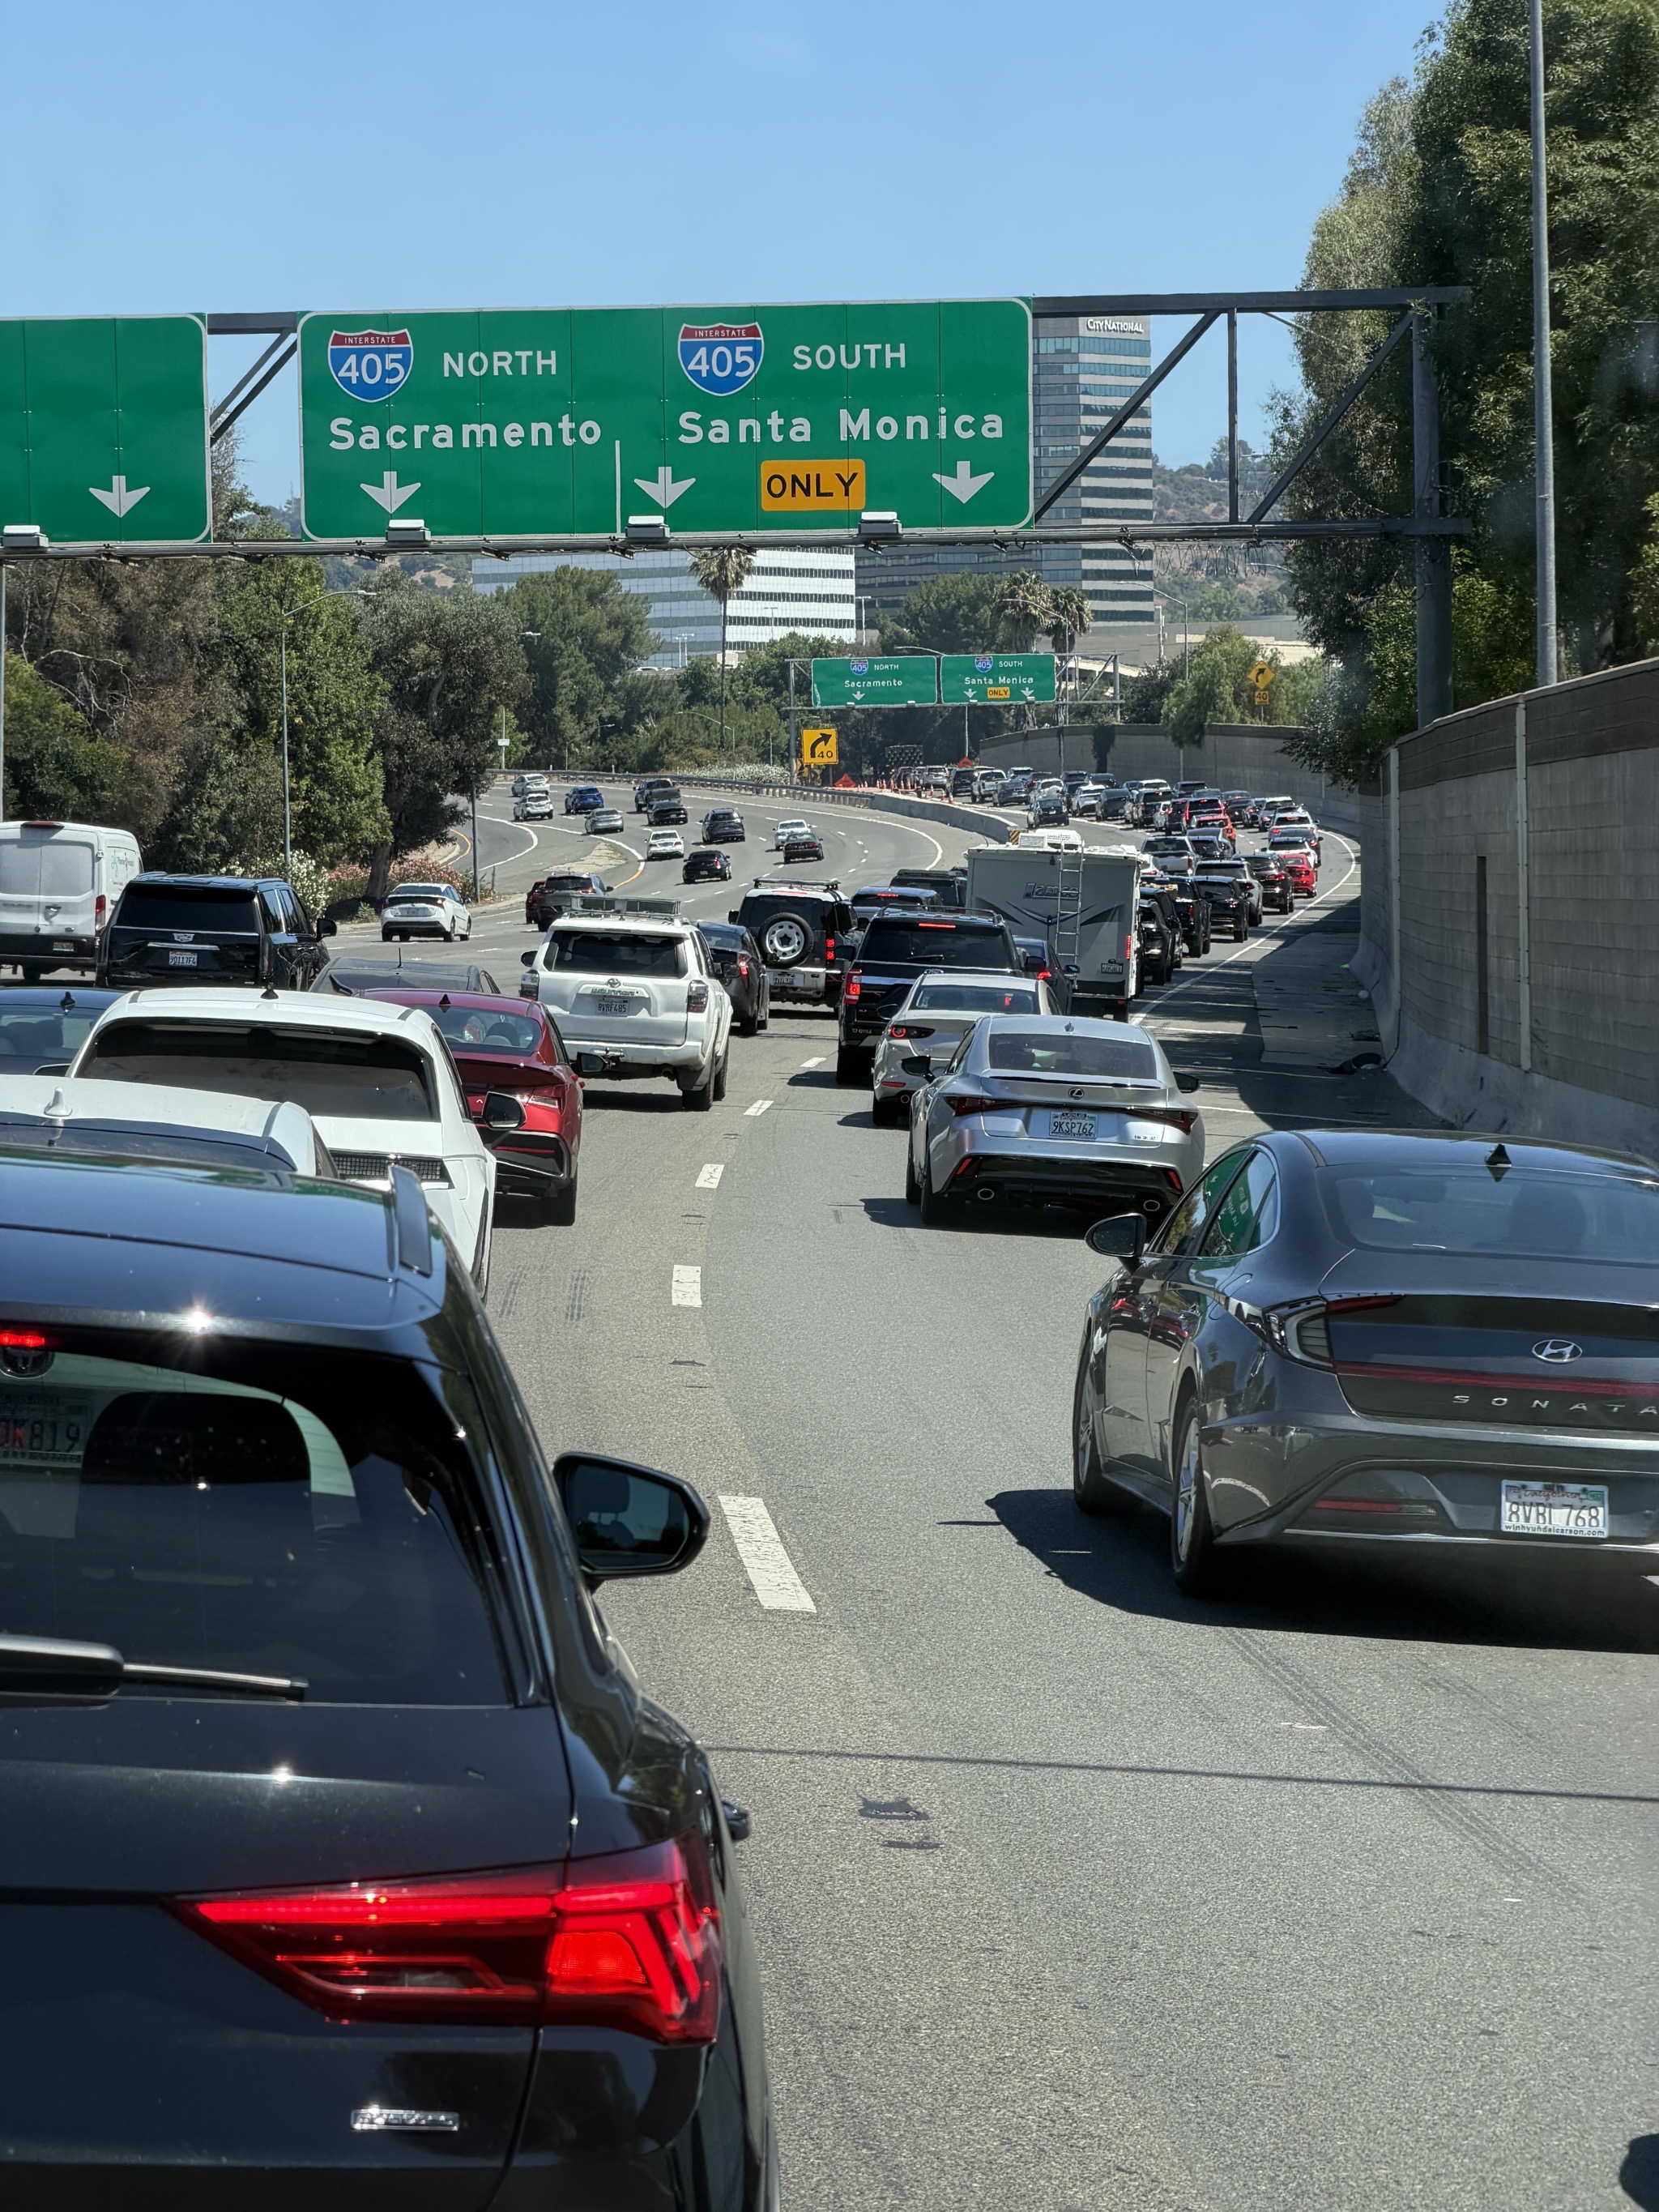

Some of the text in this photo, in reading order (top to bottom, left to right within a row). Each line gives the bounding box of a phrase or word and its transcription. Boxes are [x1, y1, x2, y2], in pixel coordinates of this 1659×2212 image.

[1104, 319, 1144, 332] NATIONAL
[344, 335, 396, 344] INTERSTATE
[694, 329, 747, 338] INTERSTATE
[687, 345, 755, 378] 405
[793, 343, 906, 370] SOUTH
[338, 353, 405, 385] 405
[443, 350, 557, 378] NORTH
[329, 413, 601, 451] Sacramento
[678, 407, 1003, 444] Santa Monica
[766, 472, 859, 498] ONLY
[976, 661, 992, 669] 405
[844, 679, 902, 688] Sacramento
[964, 676, 1034, 685] Santa Monica
[1256, 692, 1268, 701] 40
[817, 750, 834, 759] 40
[1053, 1121, 1094, 1134] 9KSP762
[1452, 1395, 1658, 1416] SONATA
[1504, 1524, 1606, 1537] winhyundaicarson.com
